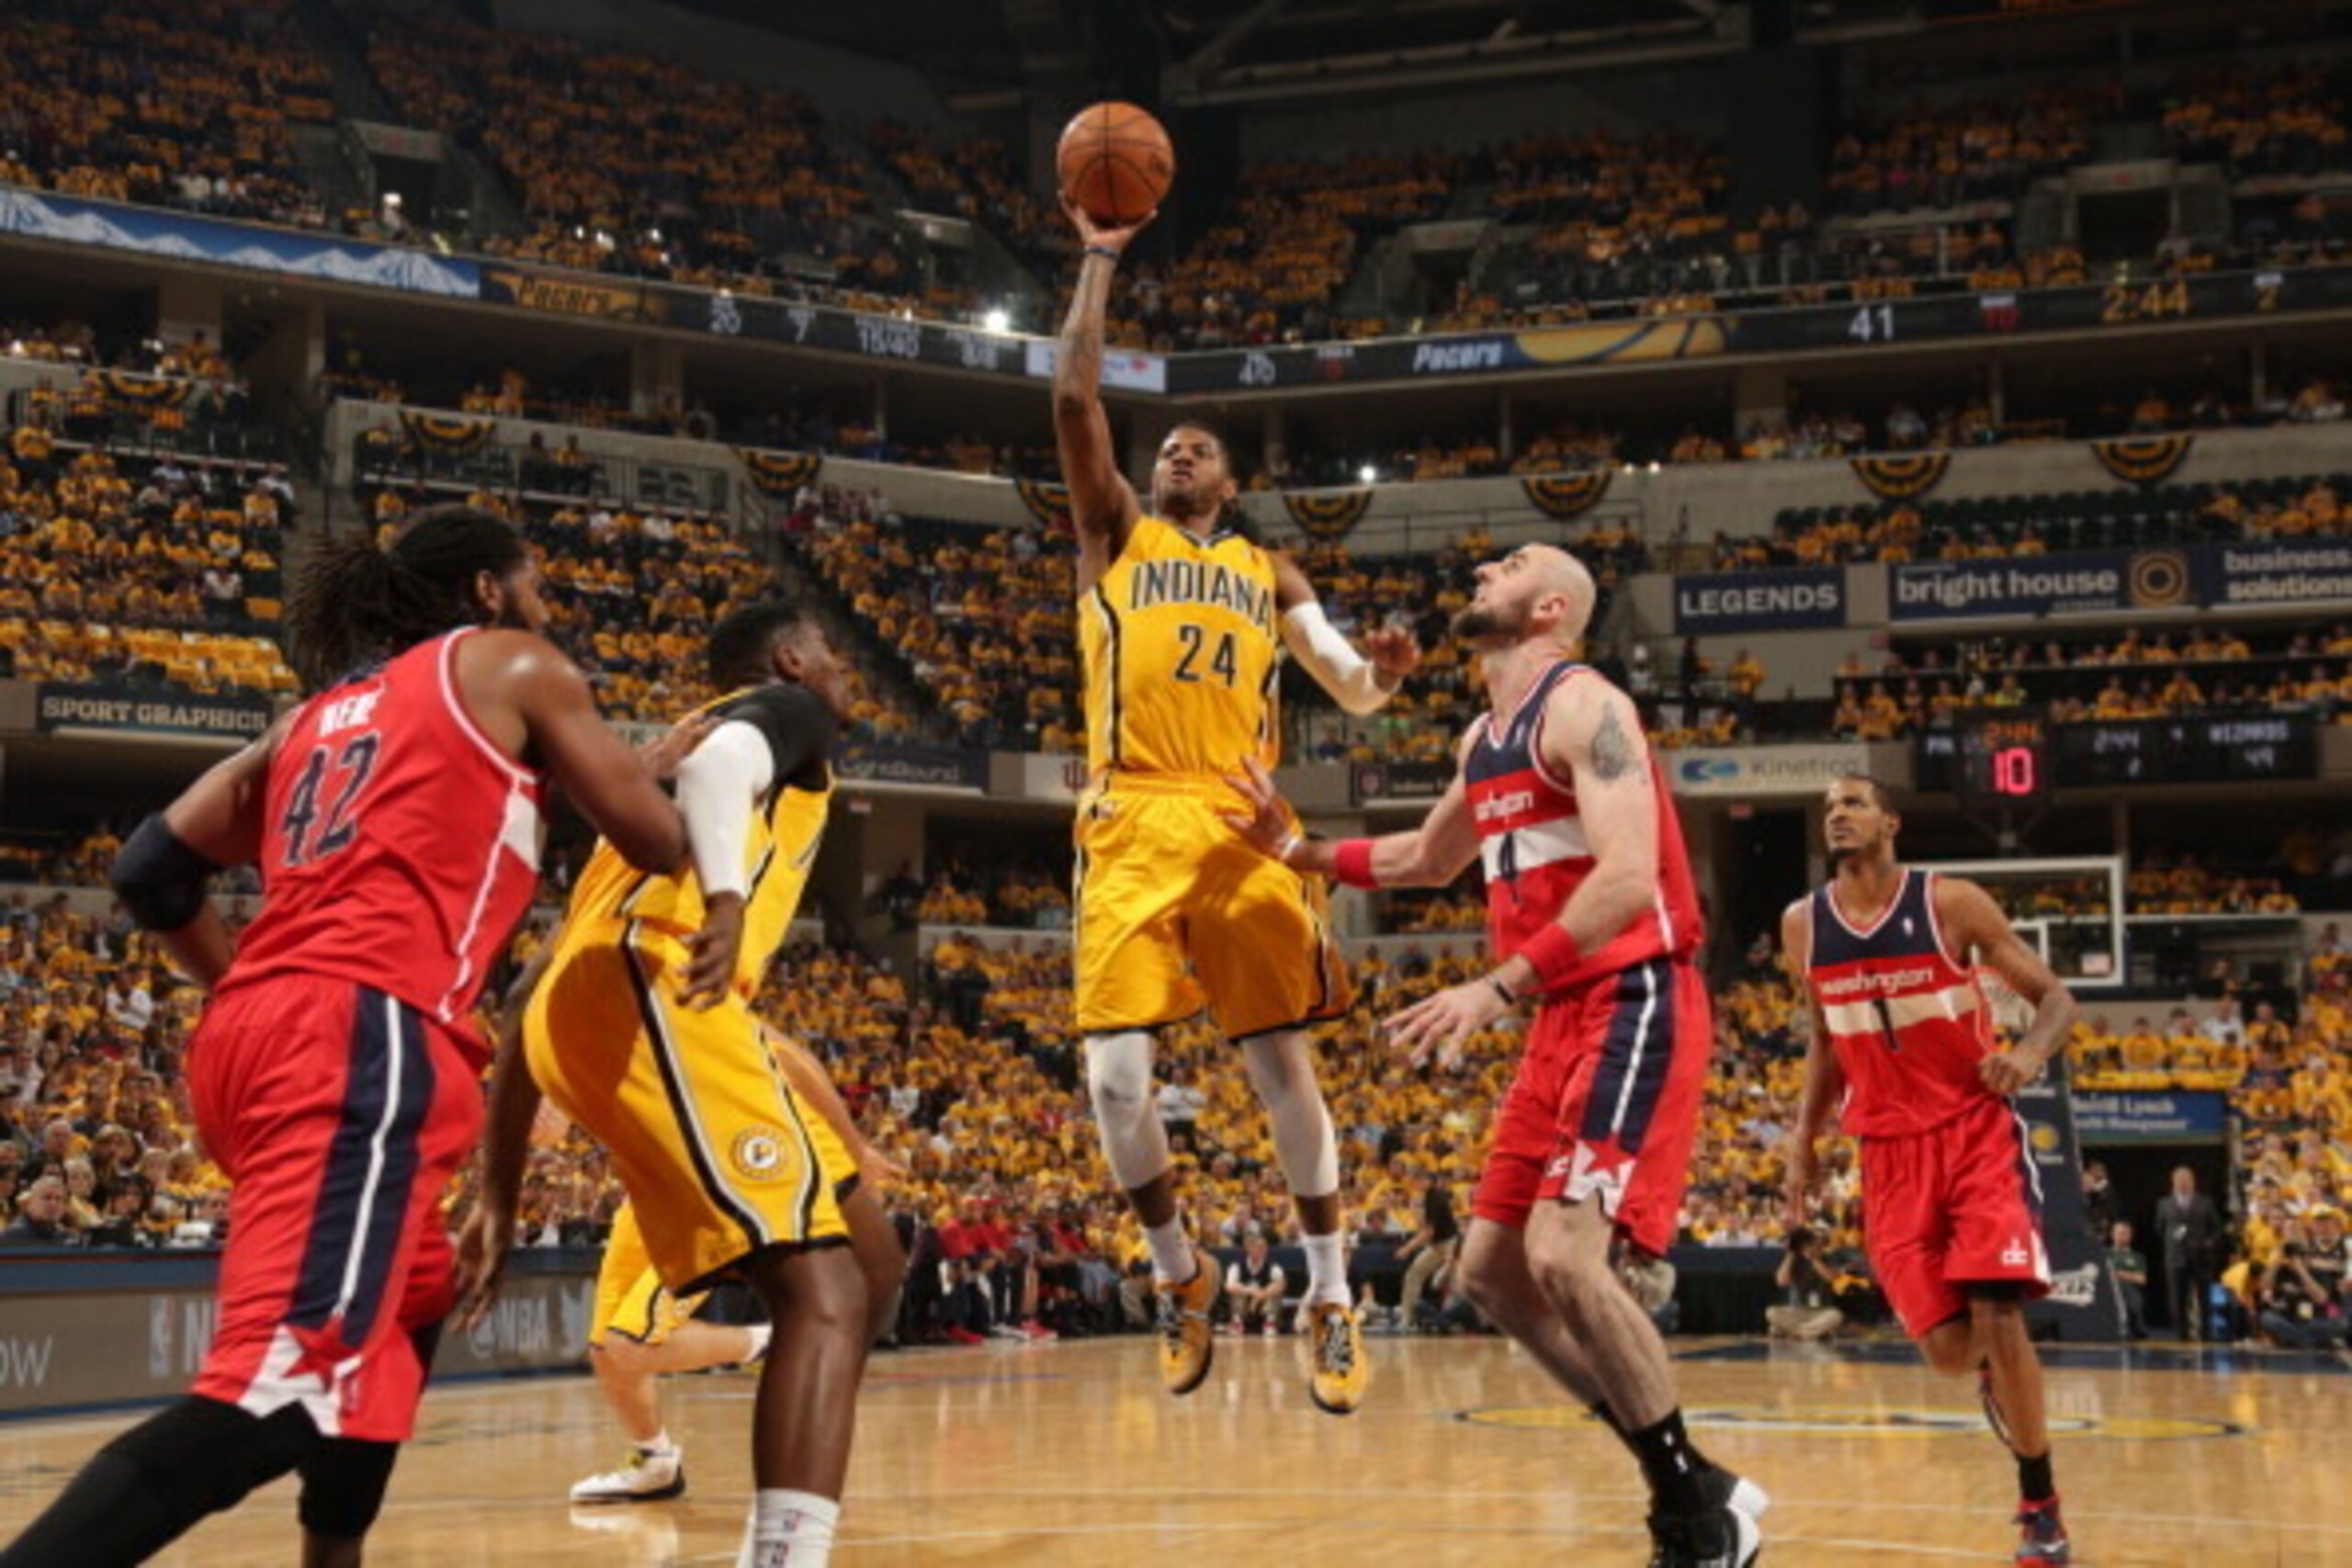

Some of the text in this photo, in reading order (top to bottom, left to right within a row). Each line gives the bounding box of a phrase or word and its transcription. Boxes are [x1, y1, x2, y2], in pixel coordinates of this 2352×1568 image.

[1849, 304, 1895, 342] 41
[1413, 341, 1504, 373] Pacers
[2224, 547, 2350, 572] business
[1131, 558, 1273, 638] INDIANA
[1681, 583, 1839, 617] LEGENDS
[1897, 568, 2120, 607] bright house
[1173, 623, 1238, 691] 24
[42, 695, 267, 731] SPORT GRAPHICS
[1994, 747, 2033, 796] 10
[281, 729, 381, 865] 42
[1819, 965, 1934, 997] washington
[1871, 997, 1900, 1052] 1
